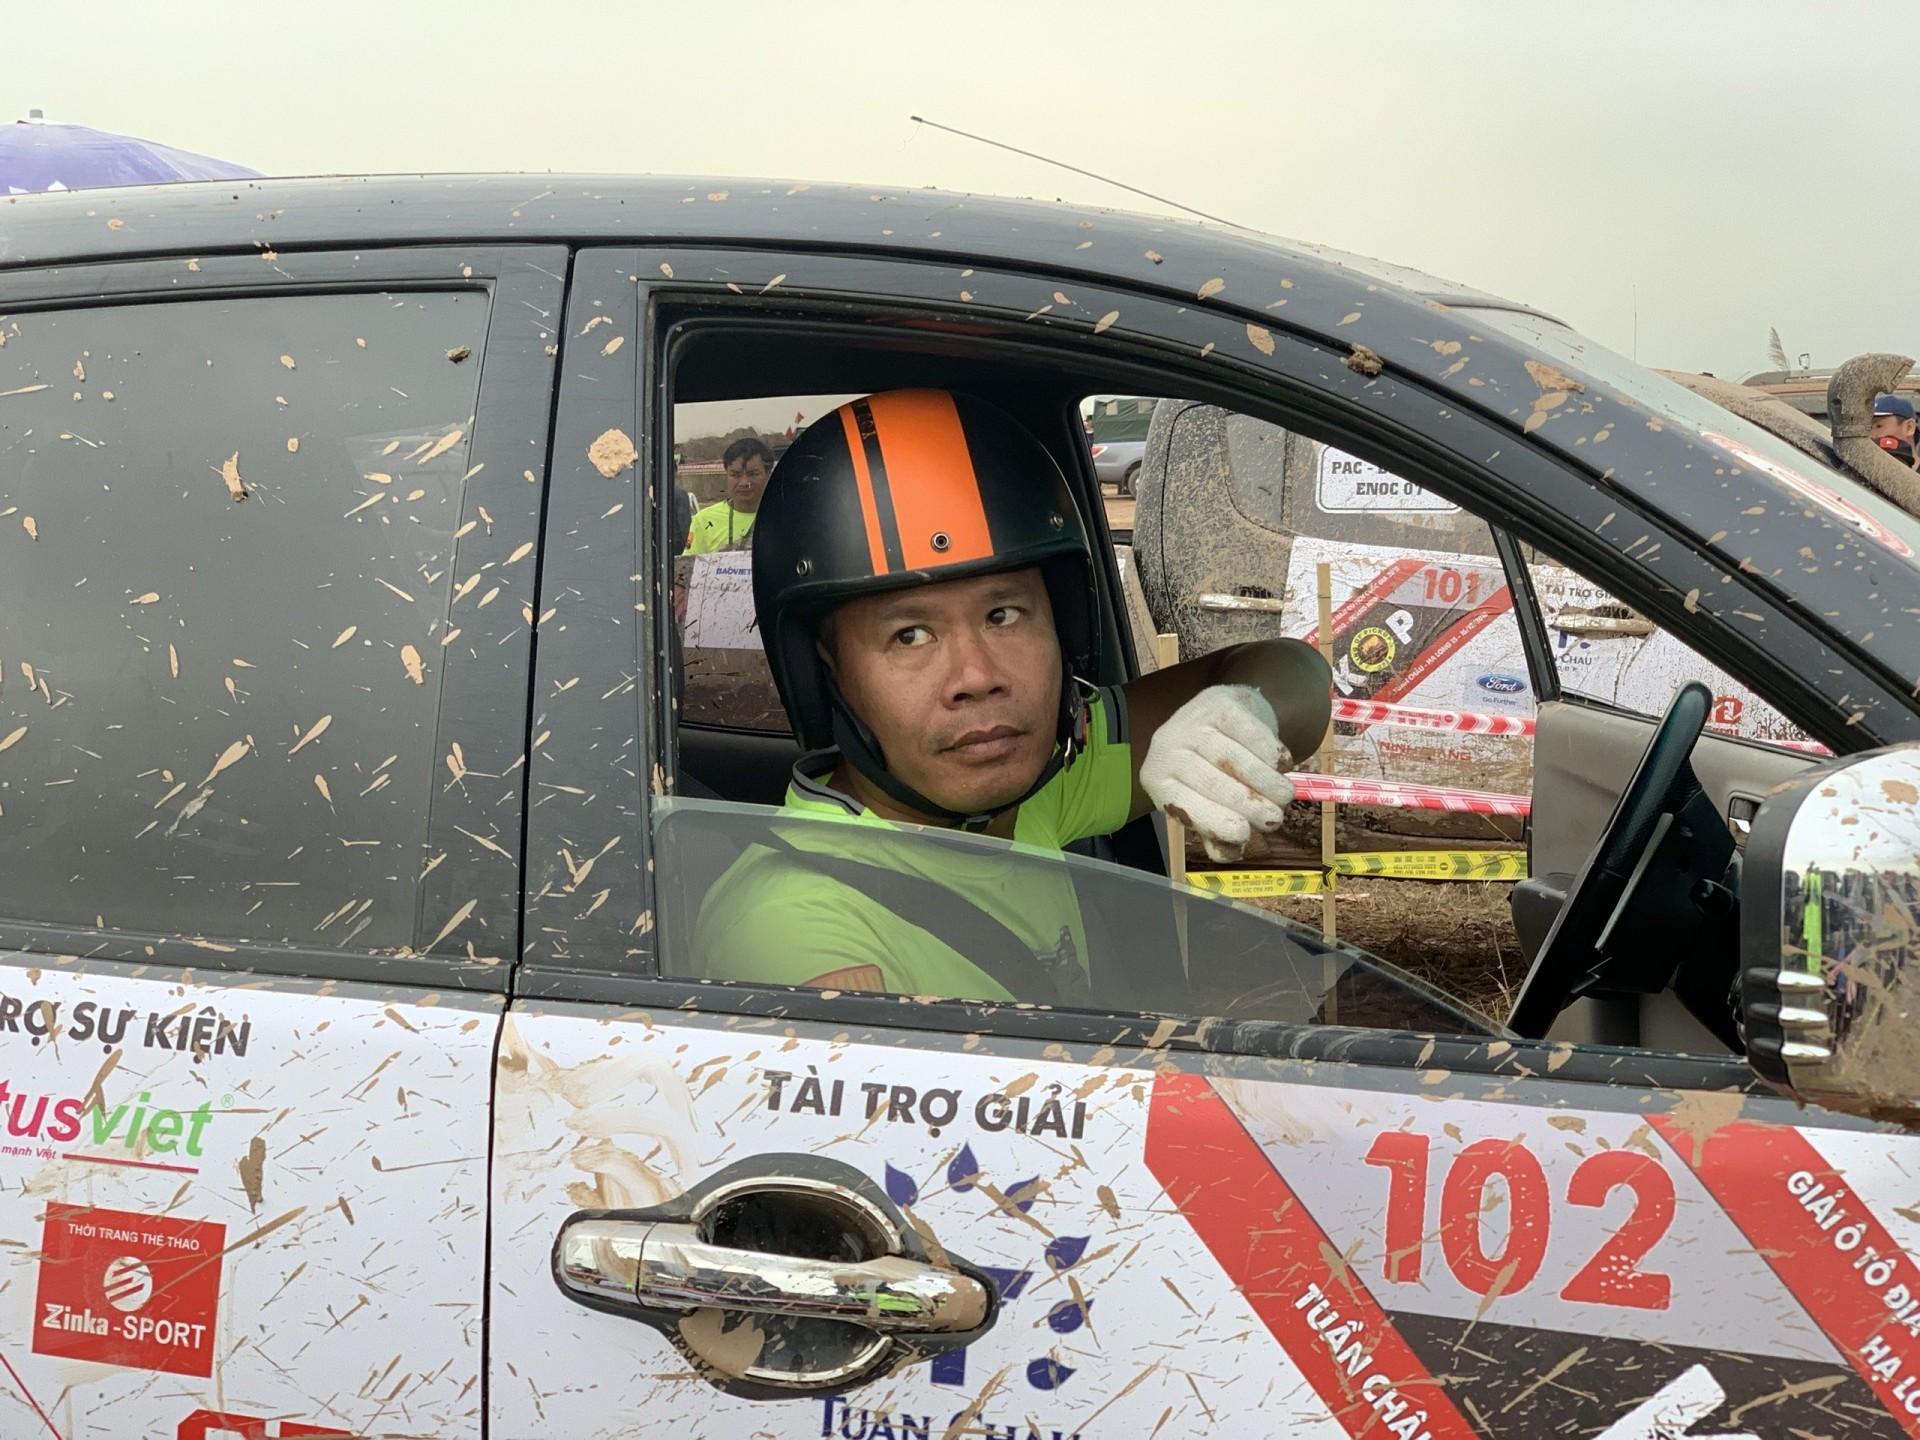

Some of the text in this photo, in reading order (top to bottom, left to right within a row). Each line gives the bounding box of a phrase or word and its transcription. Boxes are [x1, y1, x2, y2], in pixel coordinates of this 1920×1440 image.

[1332, 462, 1362, 475] PAC
[1356, 482, 1399, 496] ENOC
[1425, 568, 1479, 604] 101
[1486, 676, 1517, 692] Ford
[1493, 697, 1517, 706] Further
[68, 1001, 137, 1054] SỰ
[144, 1005, 252, 1064] KIỆN
[764, 1065, 1086, 1139] TÀI TRỢ GIẢI
[99, 1227, 138, 1243] TRANG
[167, 1235, 200, 1250] THAO
[1364, 1131, 1677, 1311] 102
[1787, 1170, 1847, 1231] GIẢI
[1834, 1222, 1867, 1251] Ô
[1853, 1246, 1898, 1287] TÔ
[42, 1303, 109, 1335] Zinka
[1294, 1282, 1374, 1378] TUẦN
[1860, 1335, 1903, 1383] HẠ
